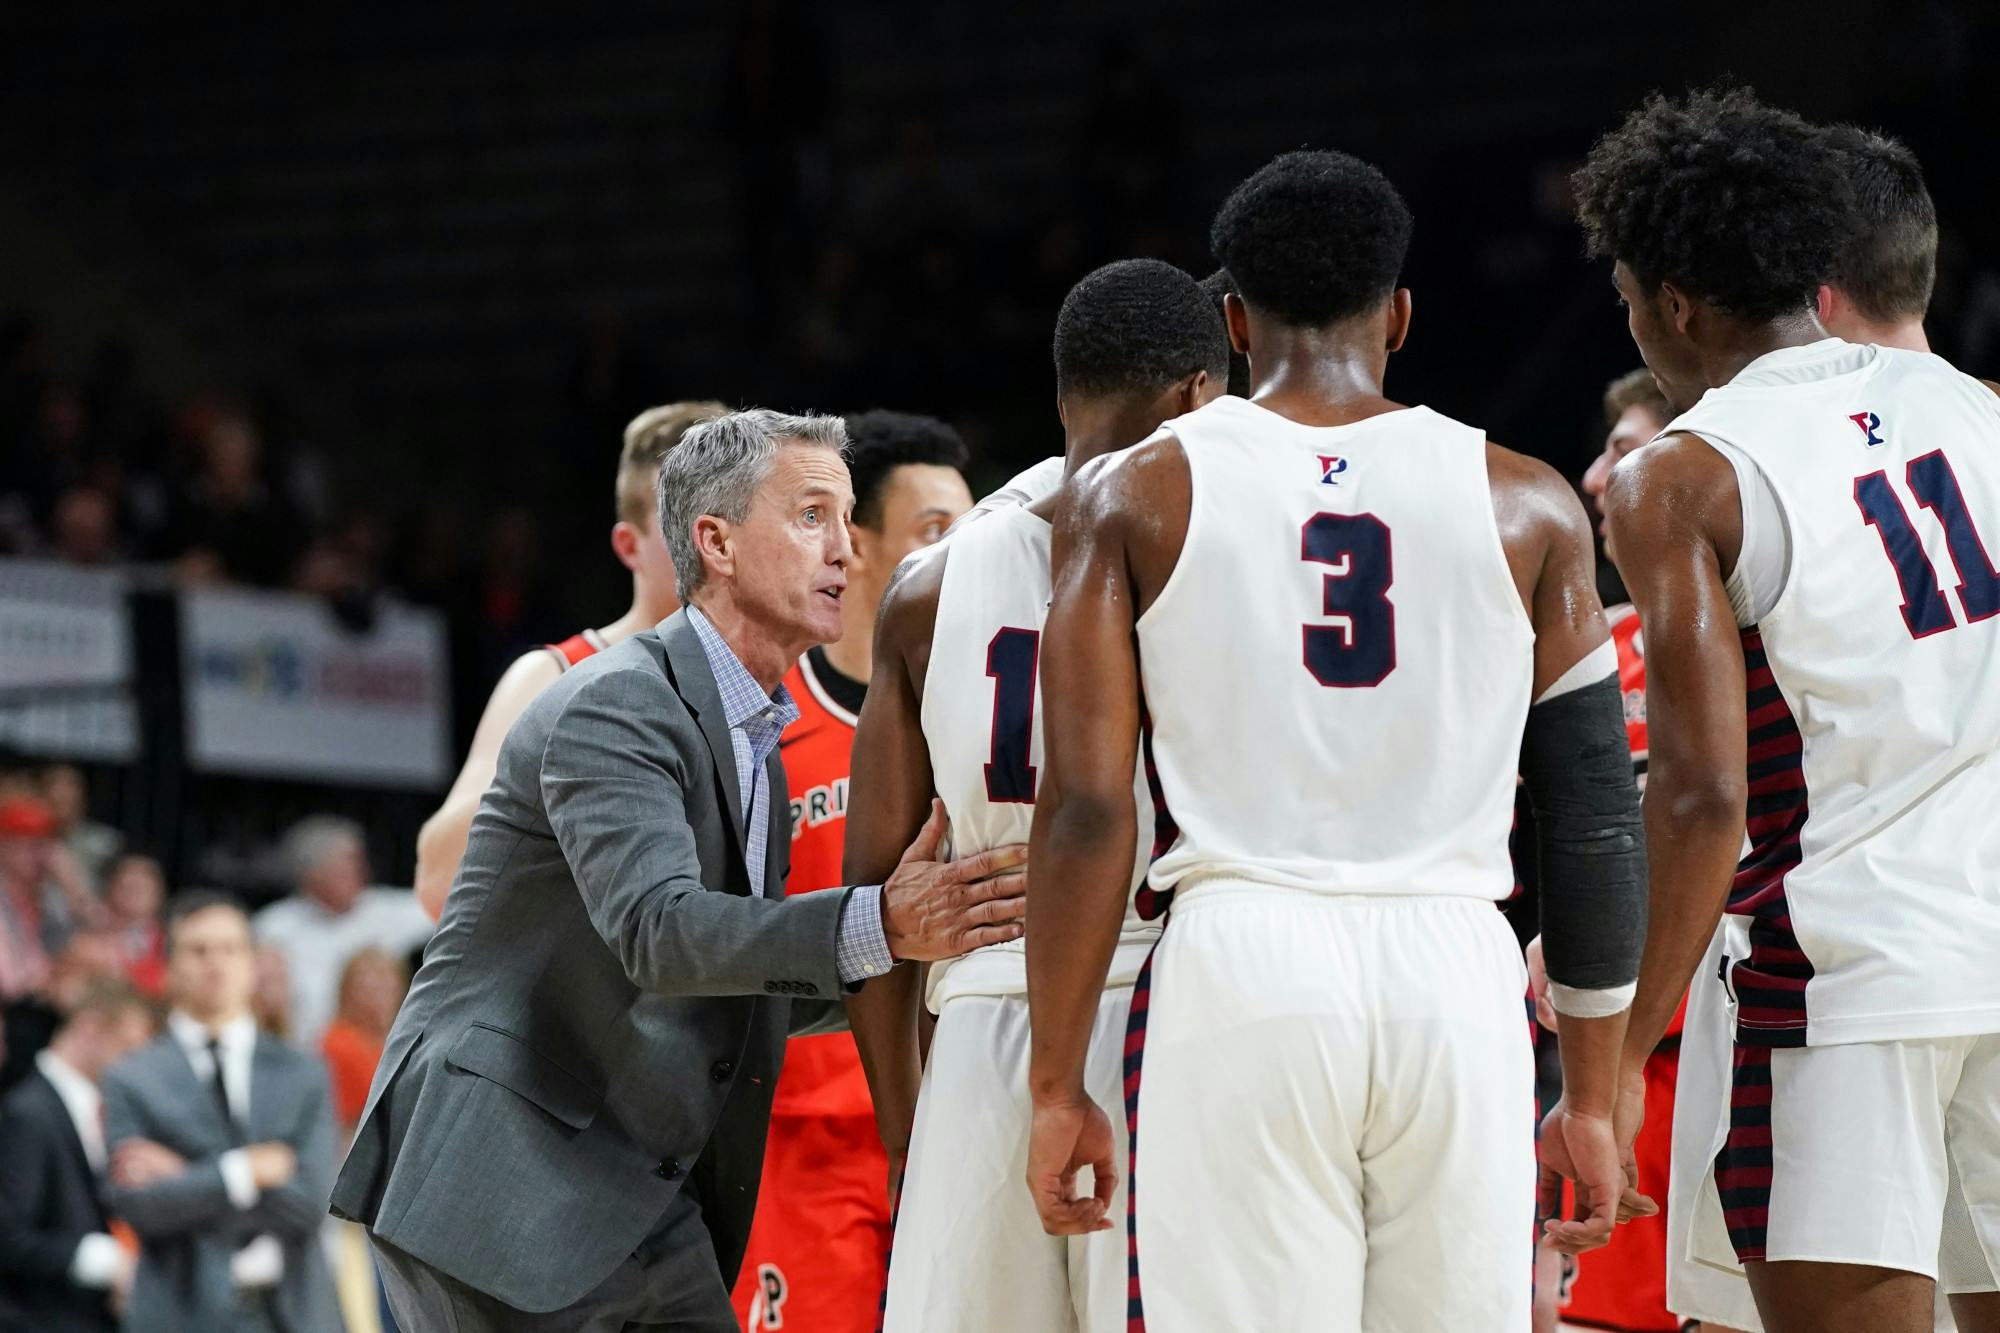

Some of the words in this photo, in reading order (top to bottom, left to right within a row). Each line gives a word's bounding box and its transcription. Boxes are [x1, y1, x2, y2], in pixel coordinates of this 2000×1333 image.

[1316, 455, 1347, 485] P
[1849, 411, 1884, 447] P
[1301, 511, 1396, 688] 3
[1853, 448, 2000, 639] 11
[984, 626, 1040, 804] 1
[758, 1263, 788, 1330] P
